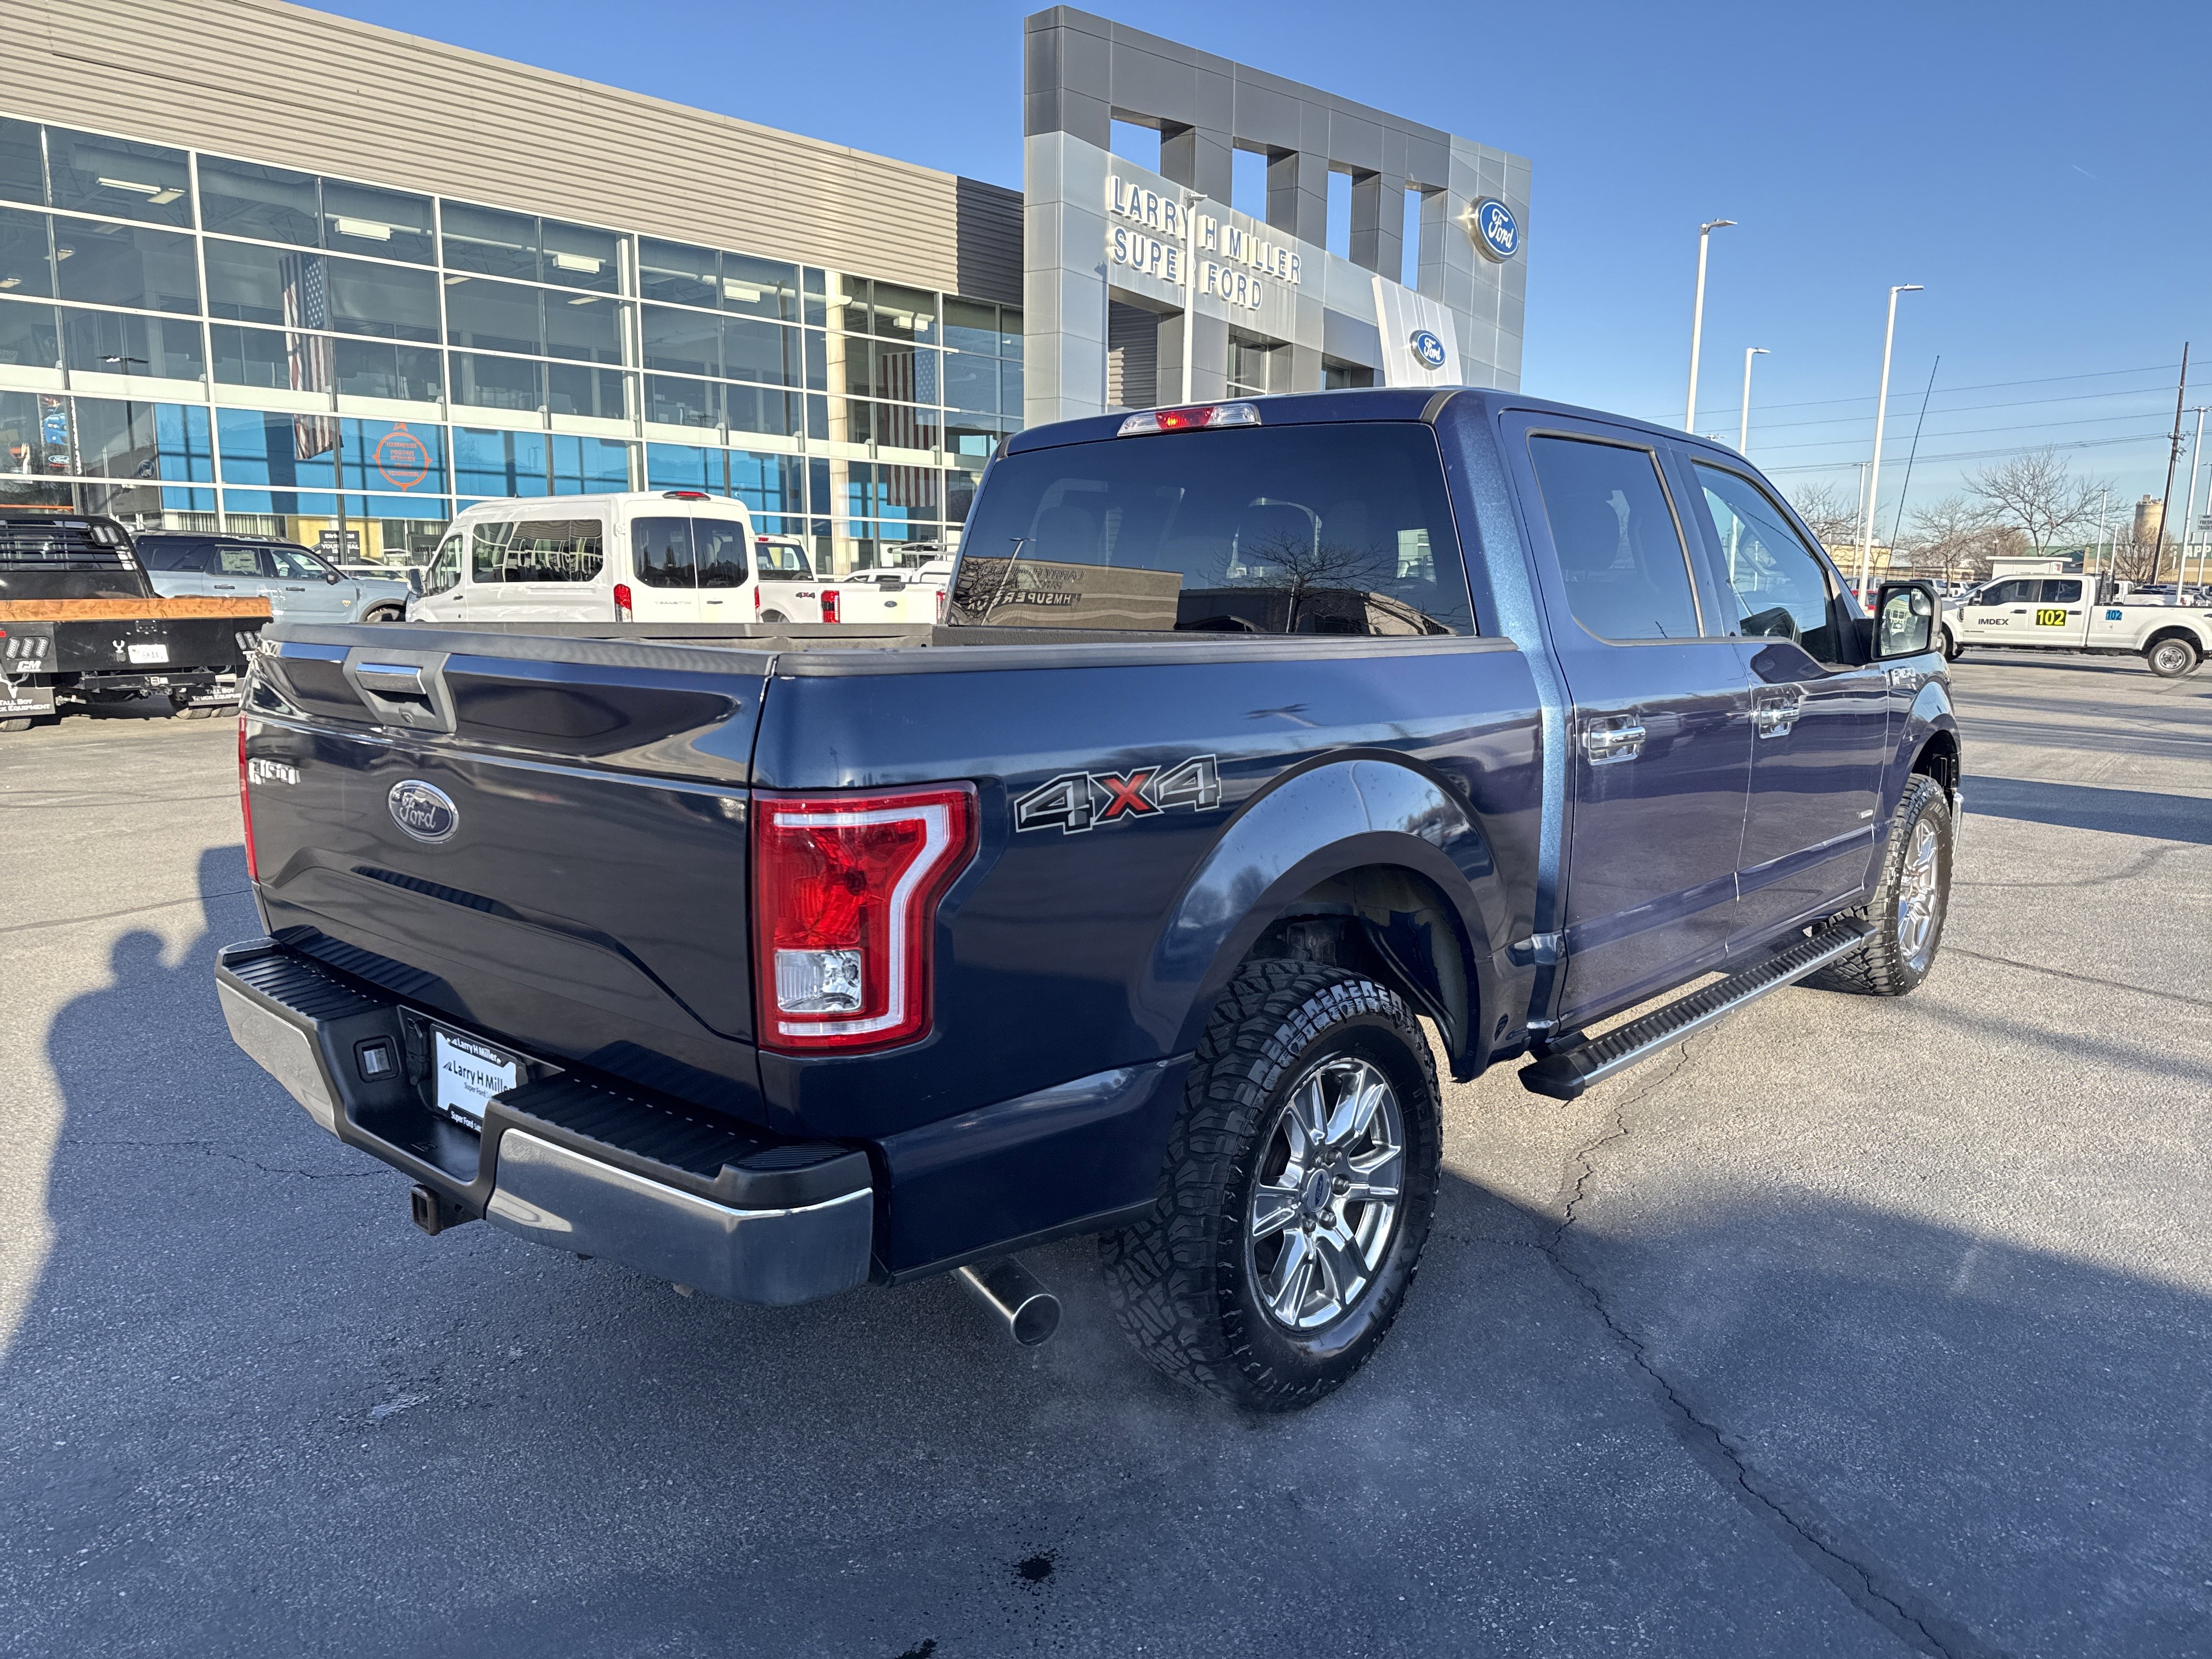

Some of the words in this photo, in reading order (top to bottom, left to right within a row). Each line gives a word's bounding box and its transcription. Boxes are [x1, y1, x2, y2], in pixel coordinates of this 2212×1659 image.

[1488, 208, 1514, 249] Ford
[1200, 215, 1217, 251] H
[1223, 225, 1301, 284] MILLER
[1203, 260, 1262, 311] FORD
[1424, 337, 1441, 360] Ford
[2038, 610, 2066, 625] 102
[2106, 610, 2123, 620] 102
[17, 660, 41, 669] CM
[399, 792, 437, 829] Ford
[457, 1037, 473, 1054] Larry
[478, 1046, 498, 1062] Miller
[453, 1059, 476, 1085] Larry
[477, 1070, 484, 1086] H
[451, 1110, 464, 1124] Super
[463, 1116, 473, 1128] Ford
